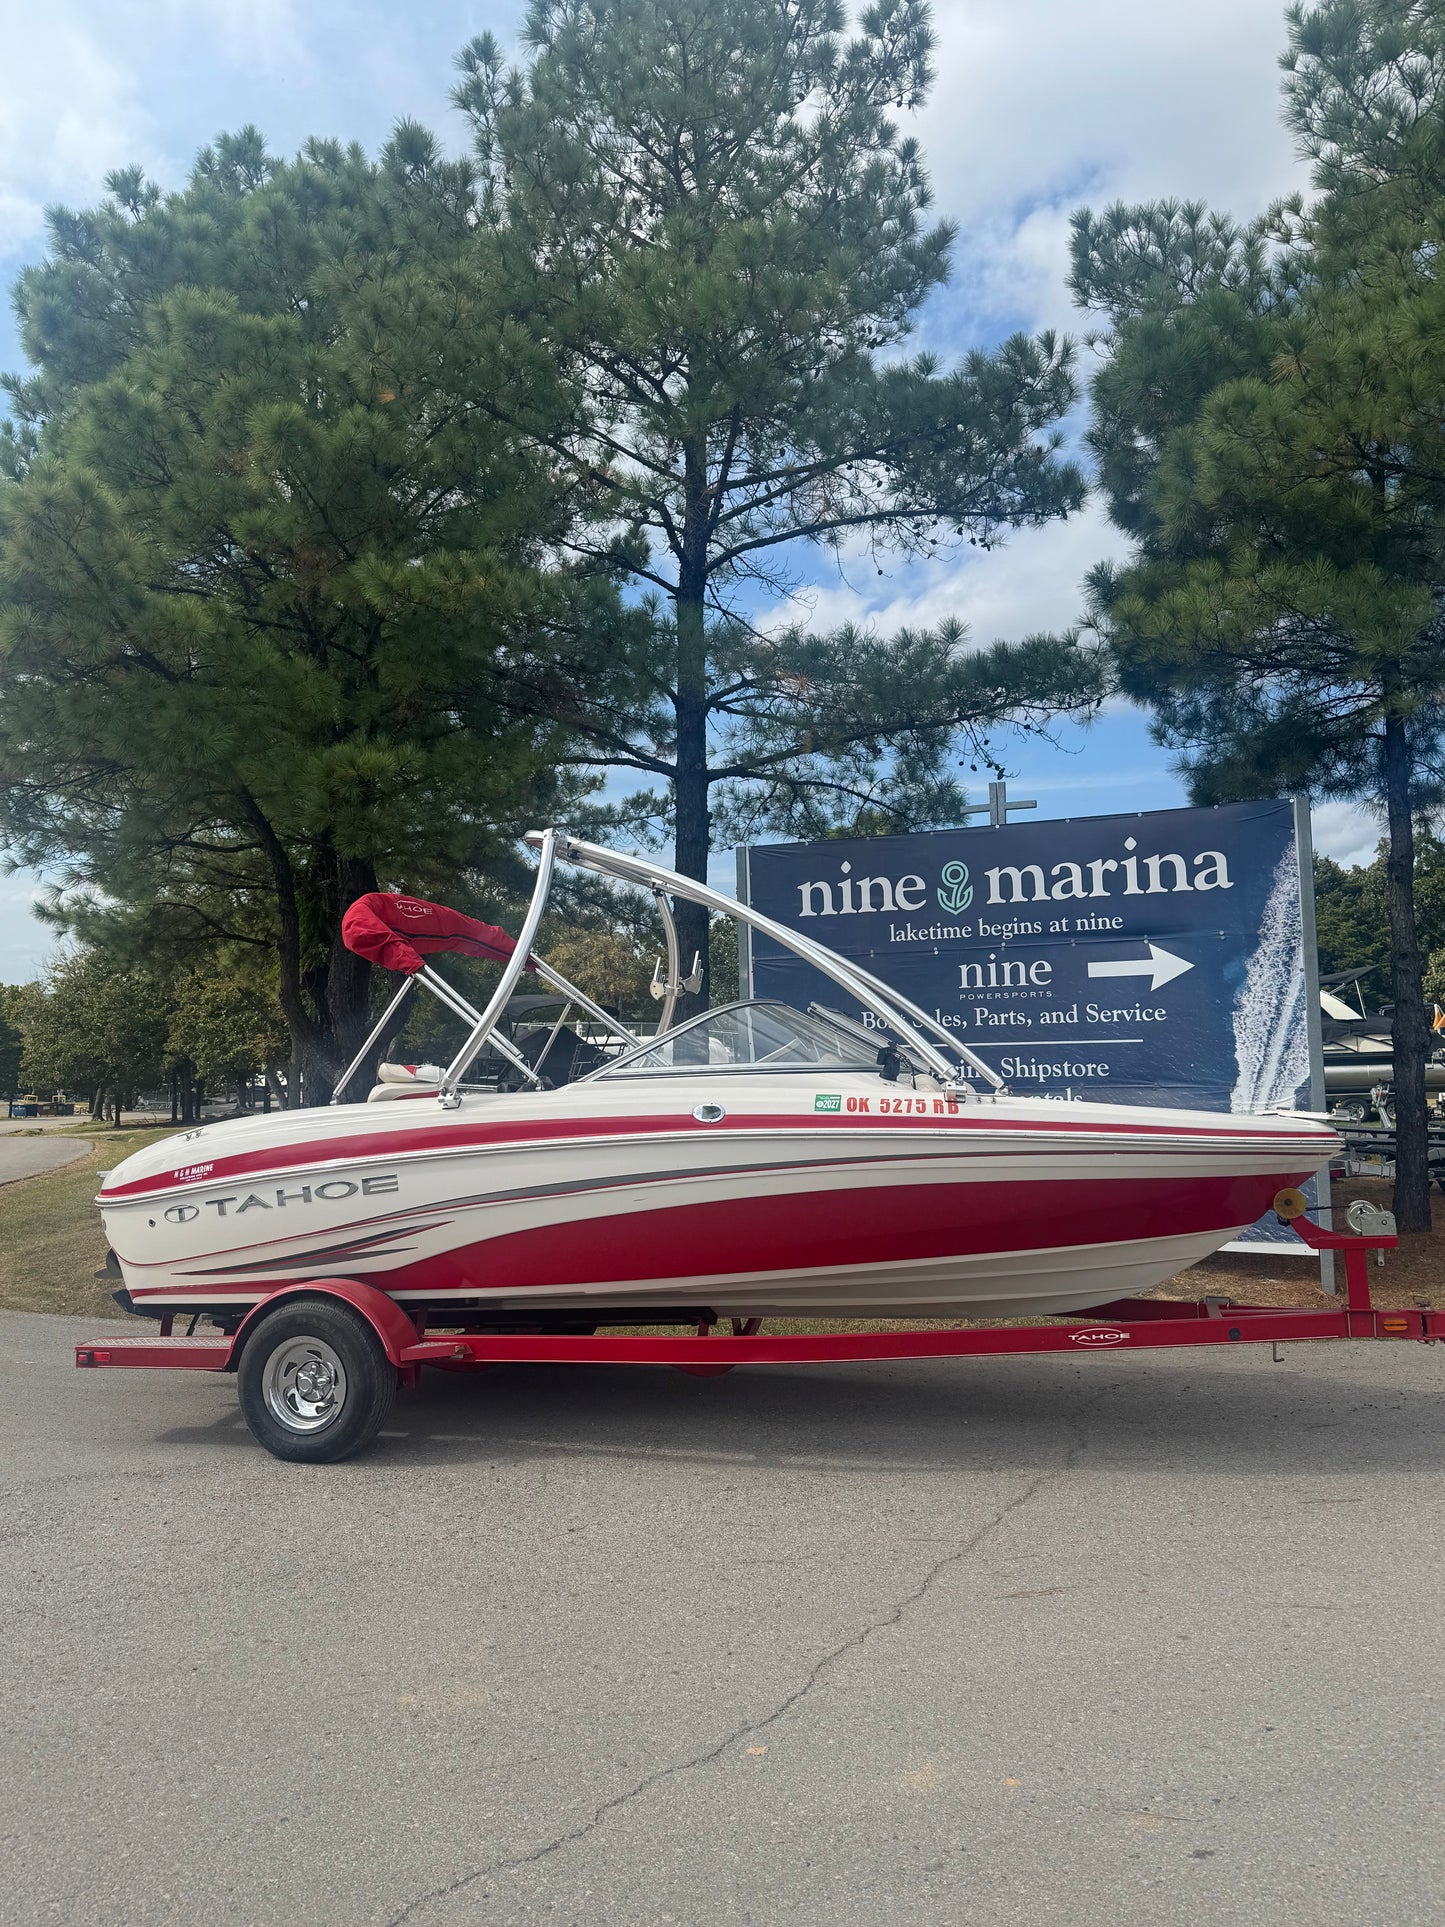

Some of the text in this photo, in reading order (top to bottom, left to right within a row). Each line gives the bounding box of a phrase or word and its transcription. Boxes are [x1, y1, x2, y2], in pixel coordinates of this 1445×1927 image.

[797, 836, 1234, 917] nine marina
[889, 913, 1123, 943] laketime begins at nine
[958, 953, 1052, 989] nine
[959, 990, 1053, 1000] POWERSPORTS
[861, 1002, 1167, 1030] Bo les, Parts, and Service
[1001, 1056, 1110, 1083] Shipstore
[823, 1100, 840, 1109] 2027
[846, 1097, 959, 1114] OK 5275 RB
[191, 1163, 214, 1174] MARINE
[205, 1173, 399, 1217] TAHOE
[1067, 1333, 1130, 1341] TAHOE
